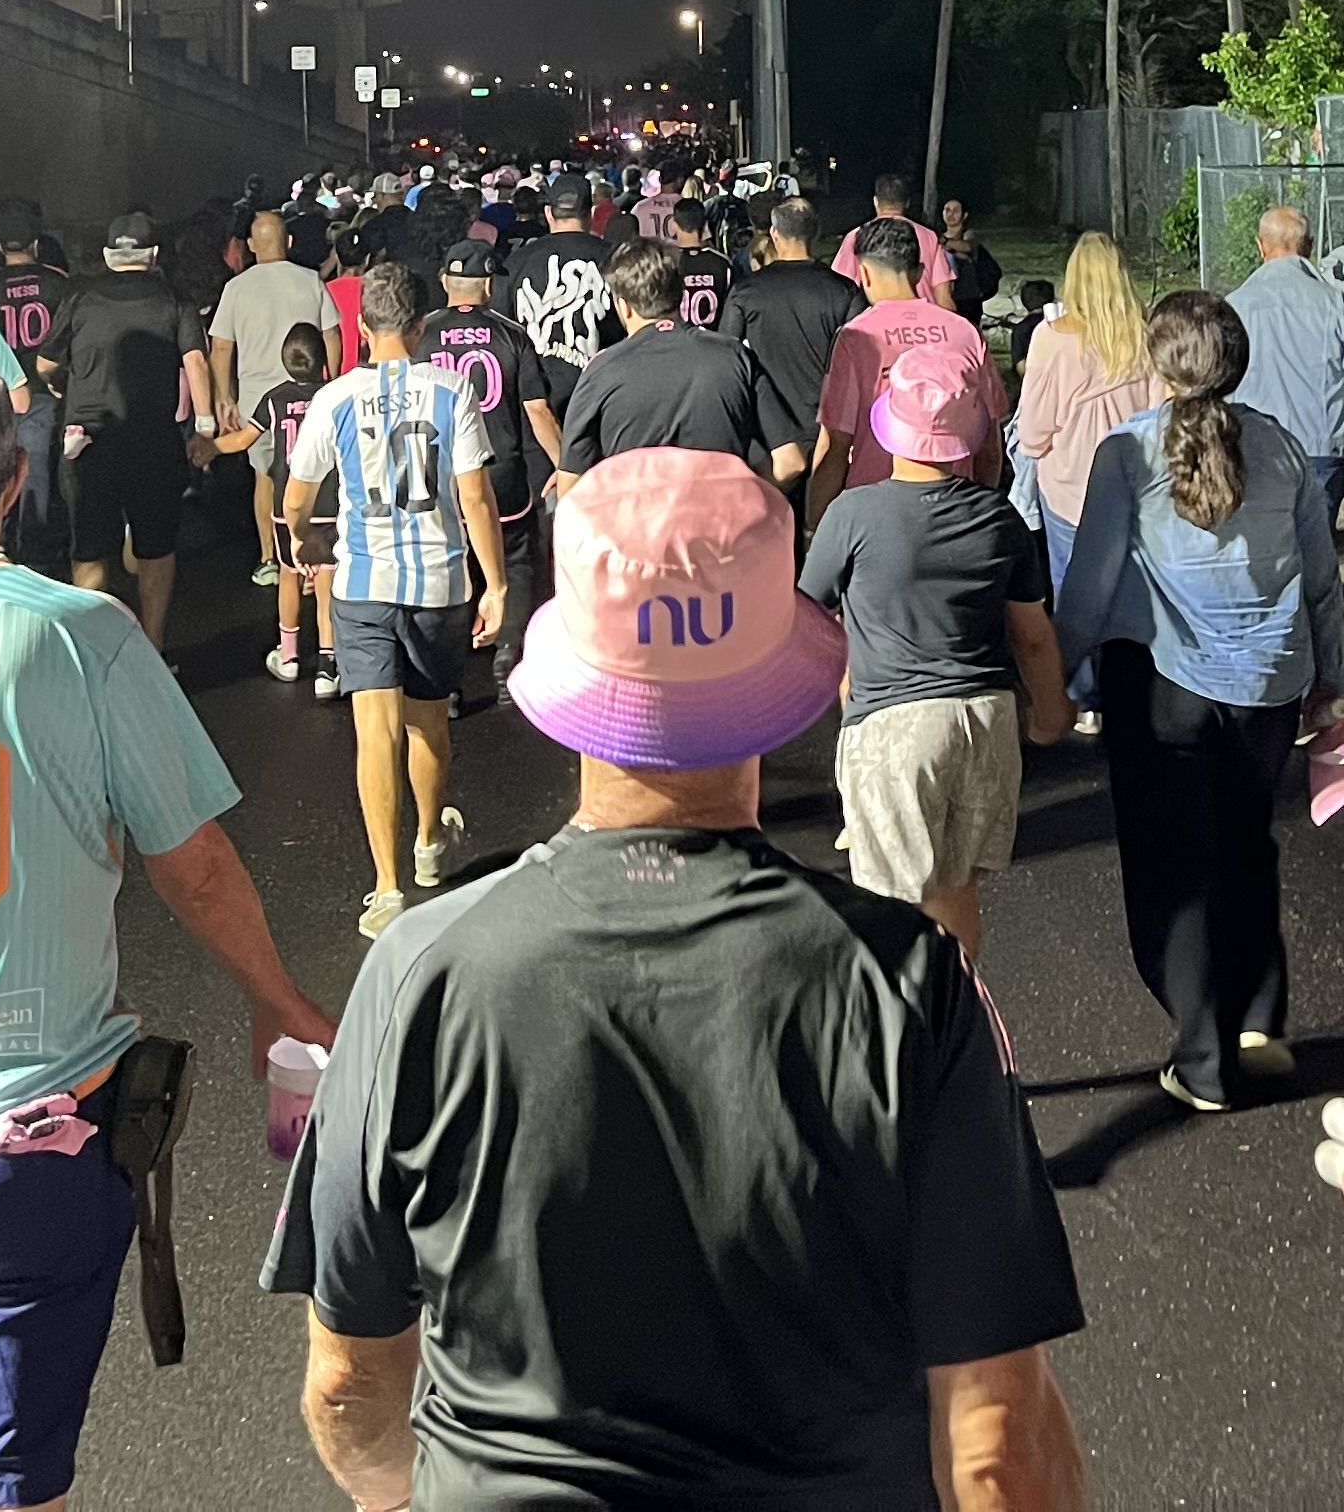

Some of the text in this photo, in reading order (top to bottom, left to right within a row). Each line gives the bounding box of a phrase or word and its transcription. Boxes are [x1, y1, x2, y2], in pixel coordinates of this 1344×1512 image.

[683, 274, 714, 287] ESSI
[7, 284, 40, 299] MESSI
[0, 302, 51, 350] 10
[884, 325, 948, 345] MESSI
[440, 327, 491, 346] MESSI
[360, 420, 440, 517] 10
[638, 591, 734, 646] nu
